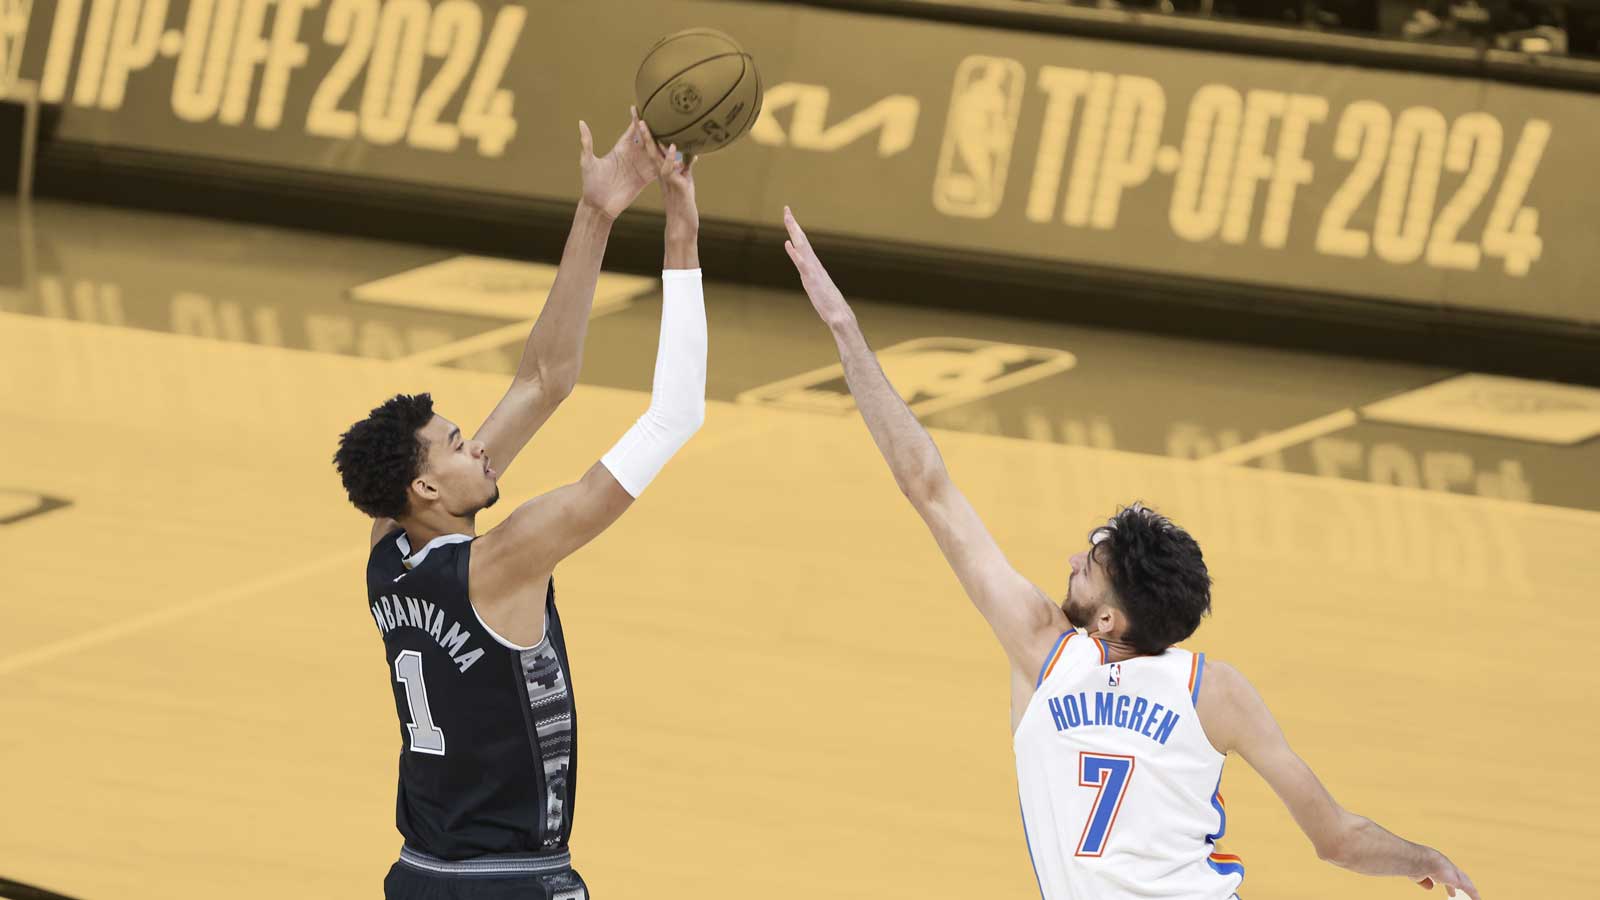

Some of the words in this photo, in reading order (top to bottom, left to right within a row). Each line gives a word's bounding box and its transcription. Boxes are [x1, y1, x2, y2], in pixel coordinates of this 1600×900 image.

[305, 0, 528, 157] 2024
[1315, 99, 1552, 278] 2024
[395, 649, 445, 756] 1
[1048, 691, 1180, 745] HOLMGREN
[1074, 751, 1135, 858] 7
